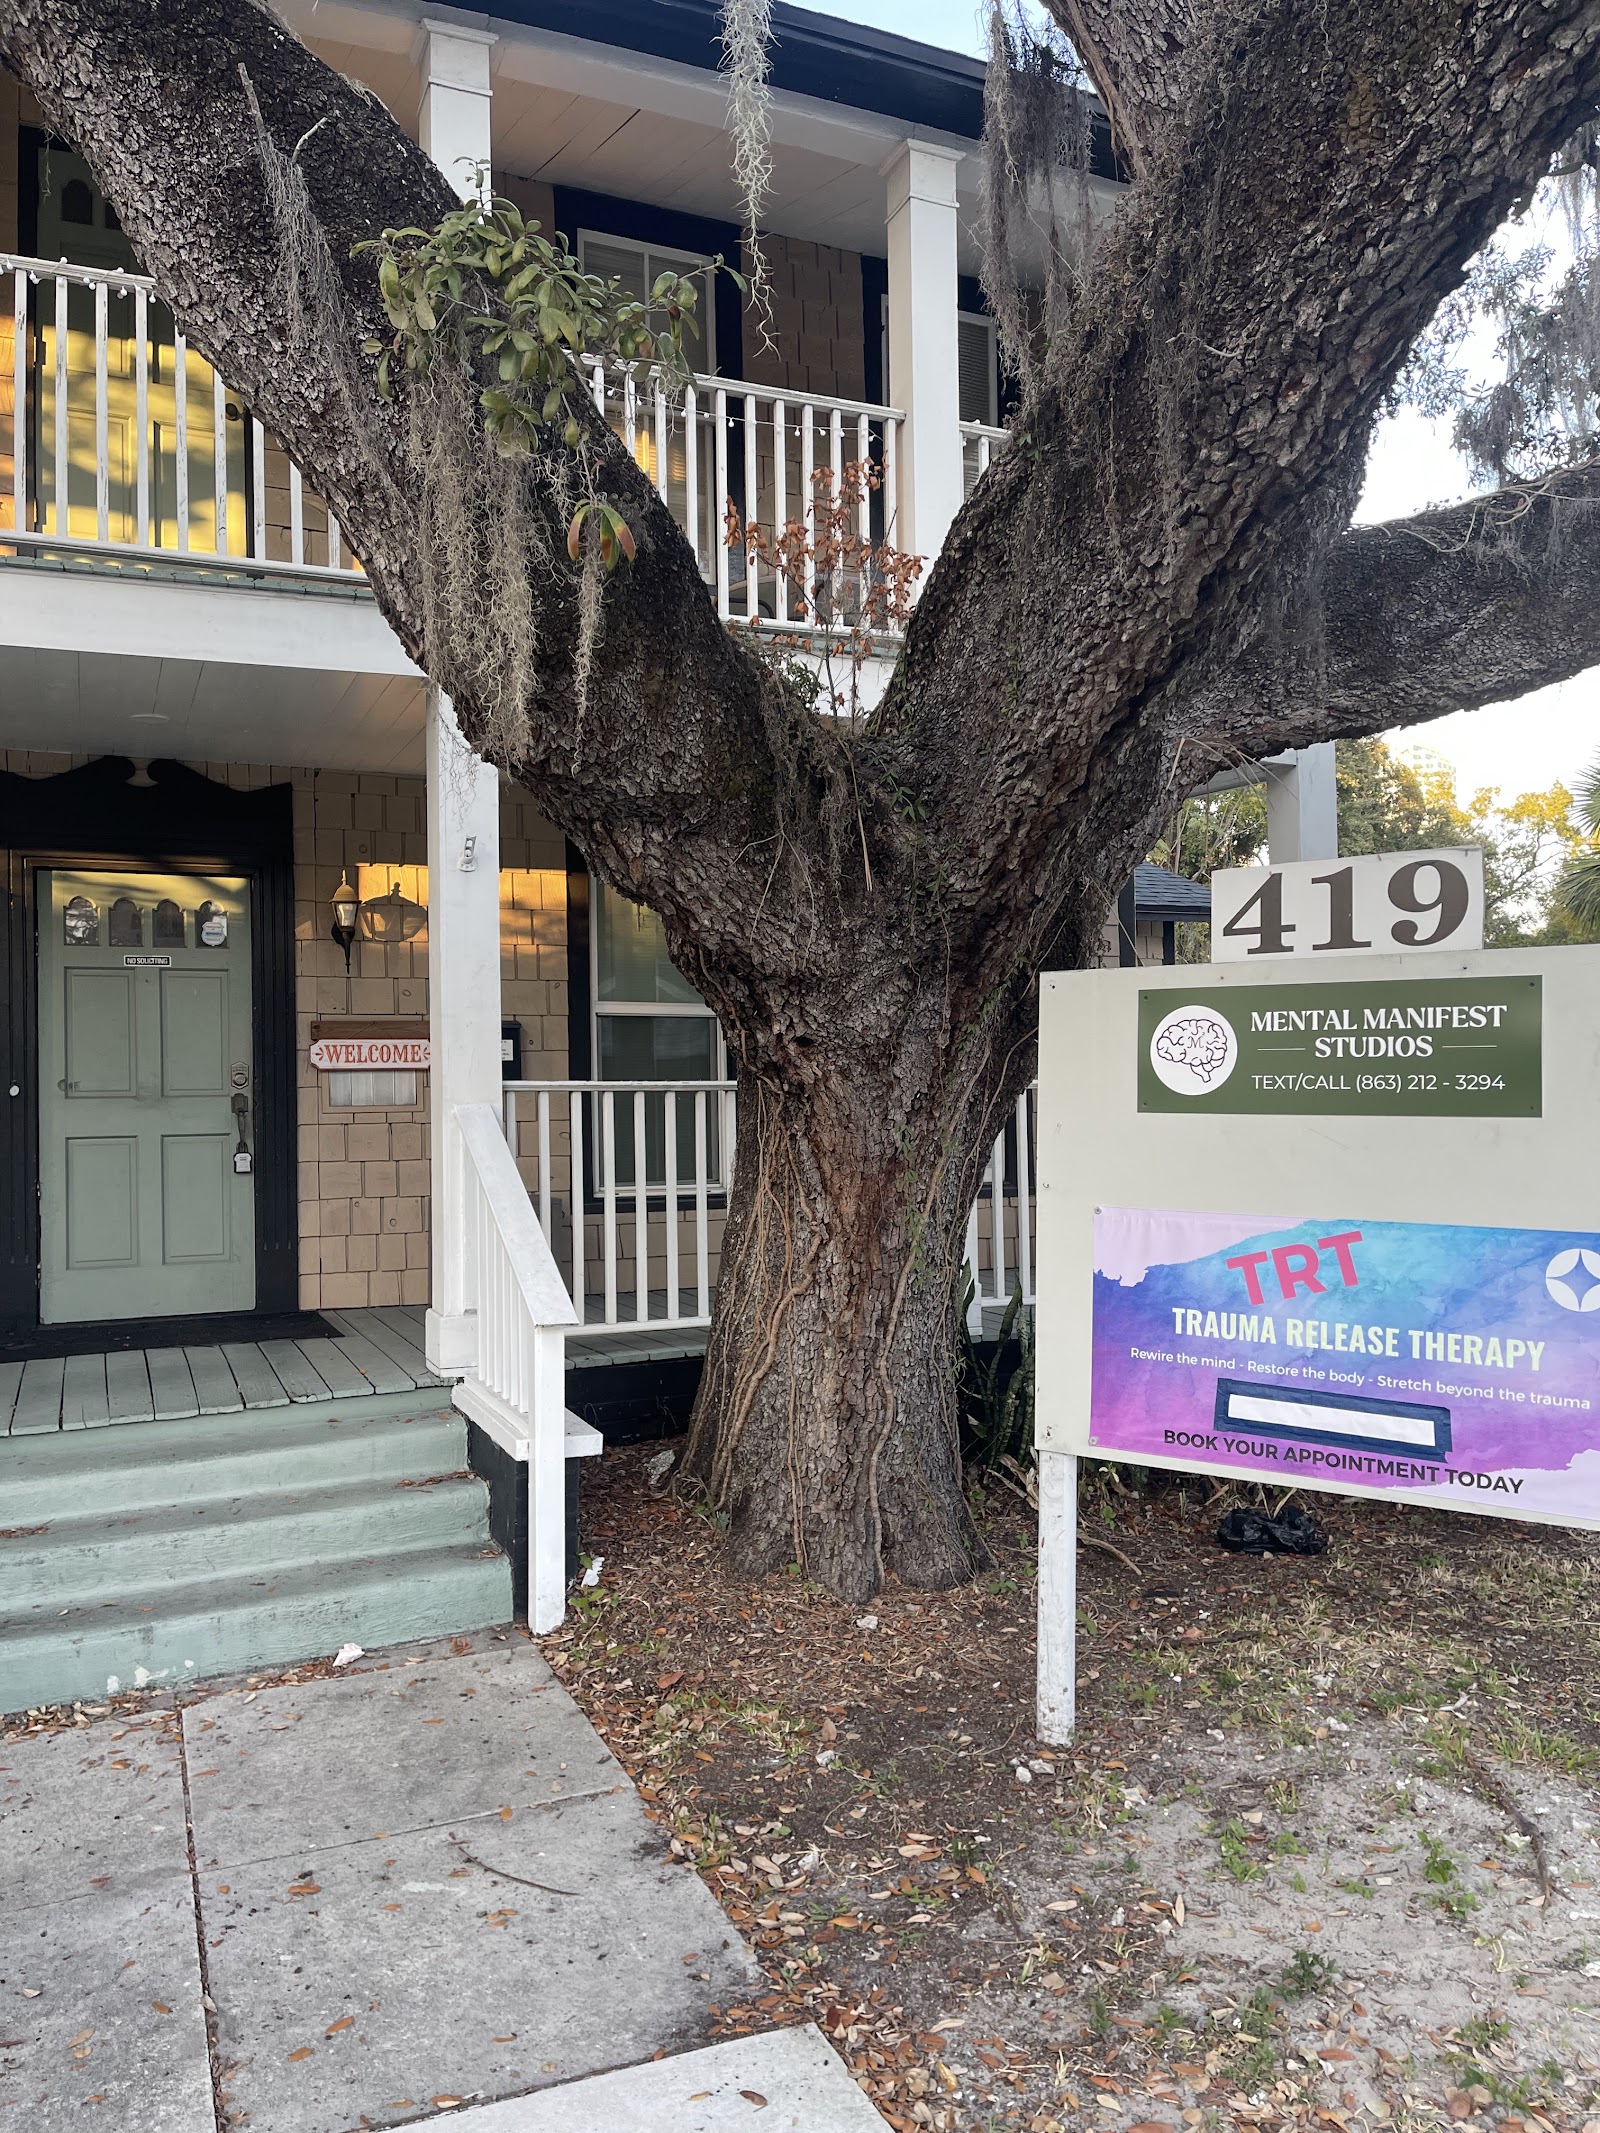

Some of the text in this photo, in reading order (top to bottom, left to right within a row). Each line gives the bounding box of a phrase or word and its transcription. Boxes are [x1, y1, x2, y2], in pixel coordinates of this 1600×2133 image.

[1222, 860, 1469, 955] 419
[127, 957, 136, 965] NO
[1250, 1005, 1508, 1032] MENTAL MANIFEST
[324, 1044, 422, 1064] WELCOME
[1315, 1035, 1433, 1058] STUDIOS
[1251, 1073, 1351, 1091] TEXT/CALL
[1356, 1074, 1402, 1093] (863)
[1407, 1075, 1438, 1090] 212
[1455, 1074, 1506, 1090] 3294
[1227, 1230, 1364, 1306] TRT
[1172, 1307, 1545, 1371] TRAUMA RELEASE THERAPY
[1130, 1347, 1174, 1362] Rewire
[1176, 1352, 1198, 1365] the
[1201, 1356, 1236, 1370] mind
[1247, 1360, 1299, 1377] Restore
[1302, 1366, 1326, 1380] the
[1329, 1369, 1365, 1387] body
[1377, 1375, 1432, 1392] Stretch
[1436, 1381, 1494, 1400] beyond
[1499, 1388, 1525, 1402] the
[1530, 1392, 1590, 1410] trauma
[1164, 1429, 1524, 1494] BOOK YOUR APPOINTMENT TODAY
